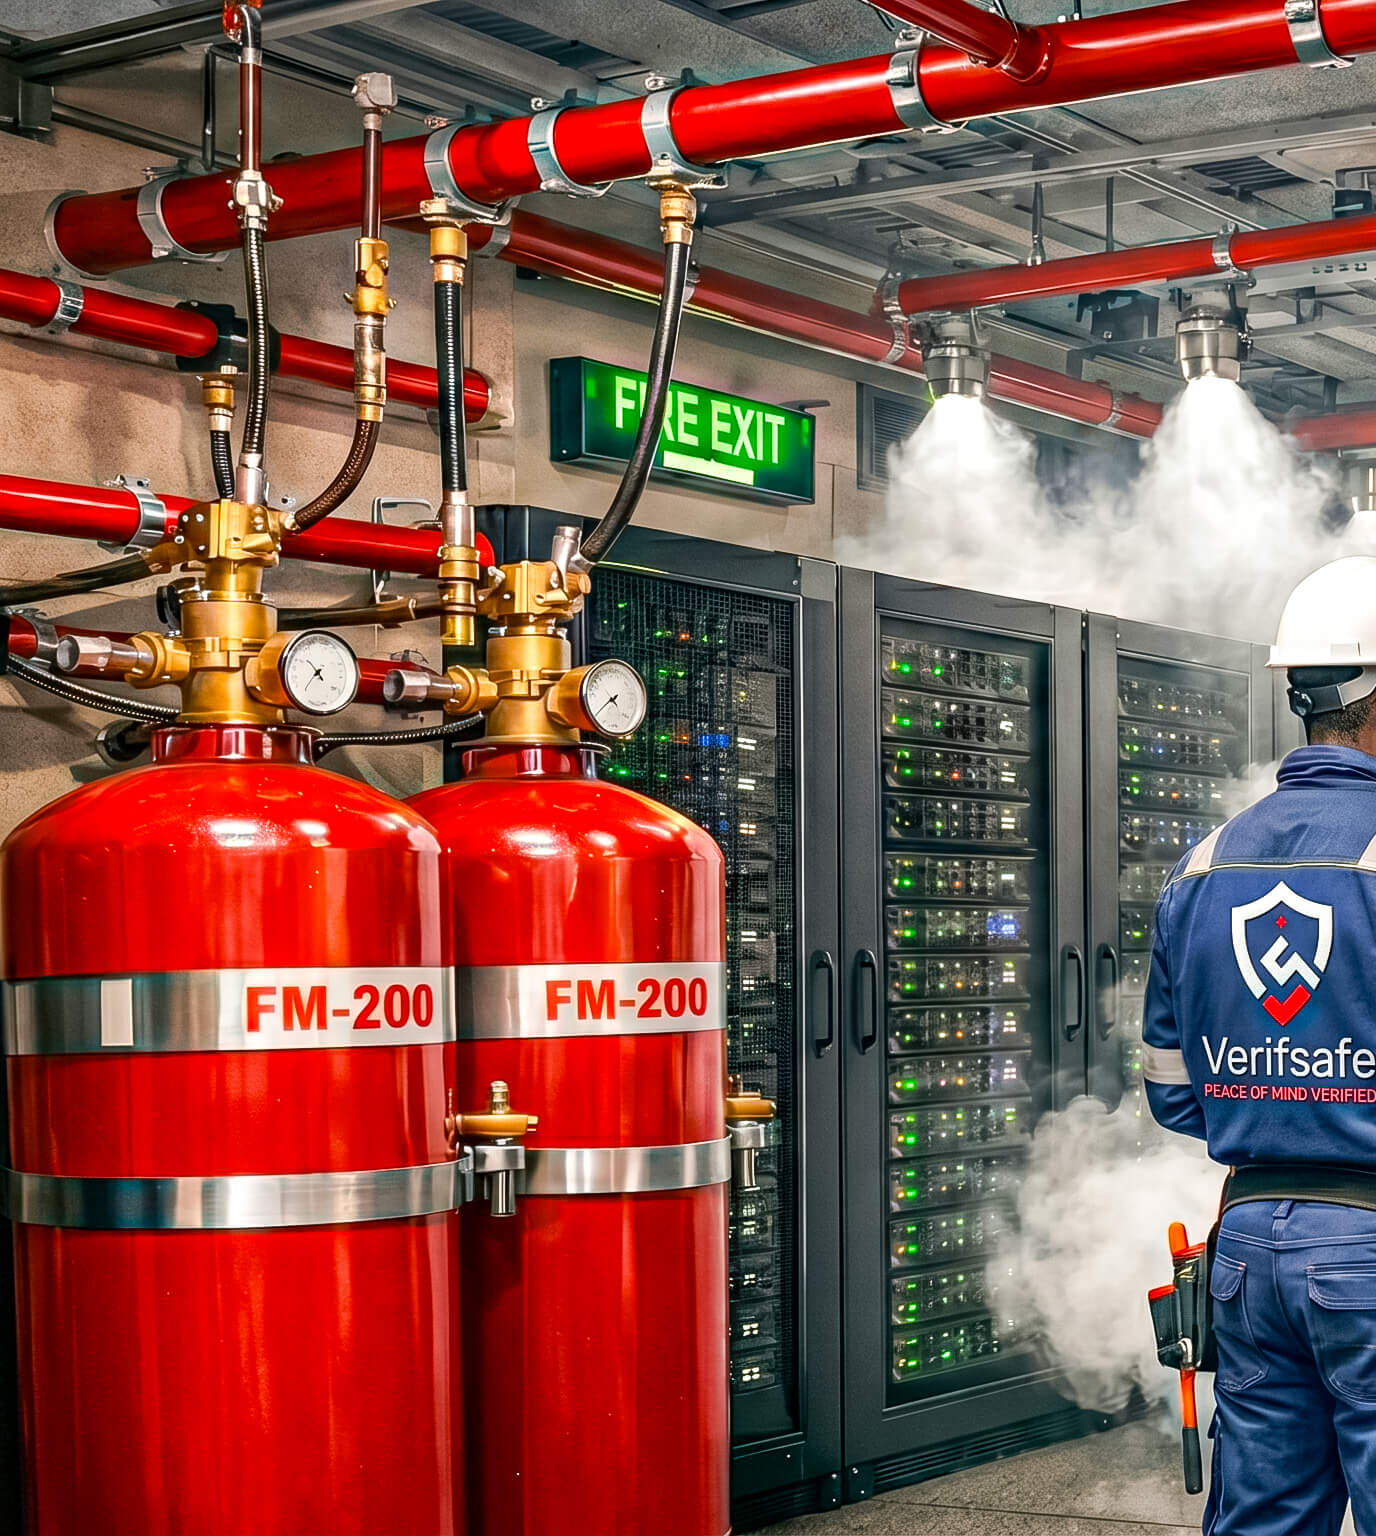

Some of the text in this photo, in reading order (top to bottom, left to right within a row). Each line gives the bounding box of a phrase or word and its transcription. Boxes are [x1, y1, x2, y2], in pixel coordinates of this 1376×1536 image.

[615, 375, 785, 464] FE EXIT
[246, 983, 434, 1032] FM-200
[545, 977, 708, 1021] FM-200
[1201, 1035, 1376, 1079] Verifsafe
[1204, 1083, 1248, 1099] PEACE
[1250, 1085, 1269, 1100] OF
[1271, 1086, 1308, 1101] MIND
